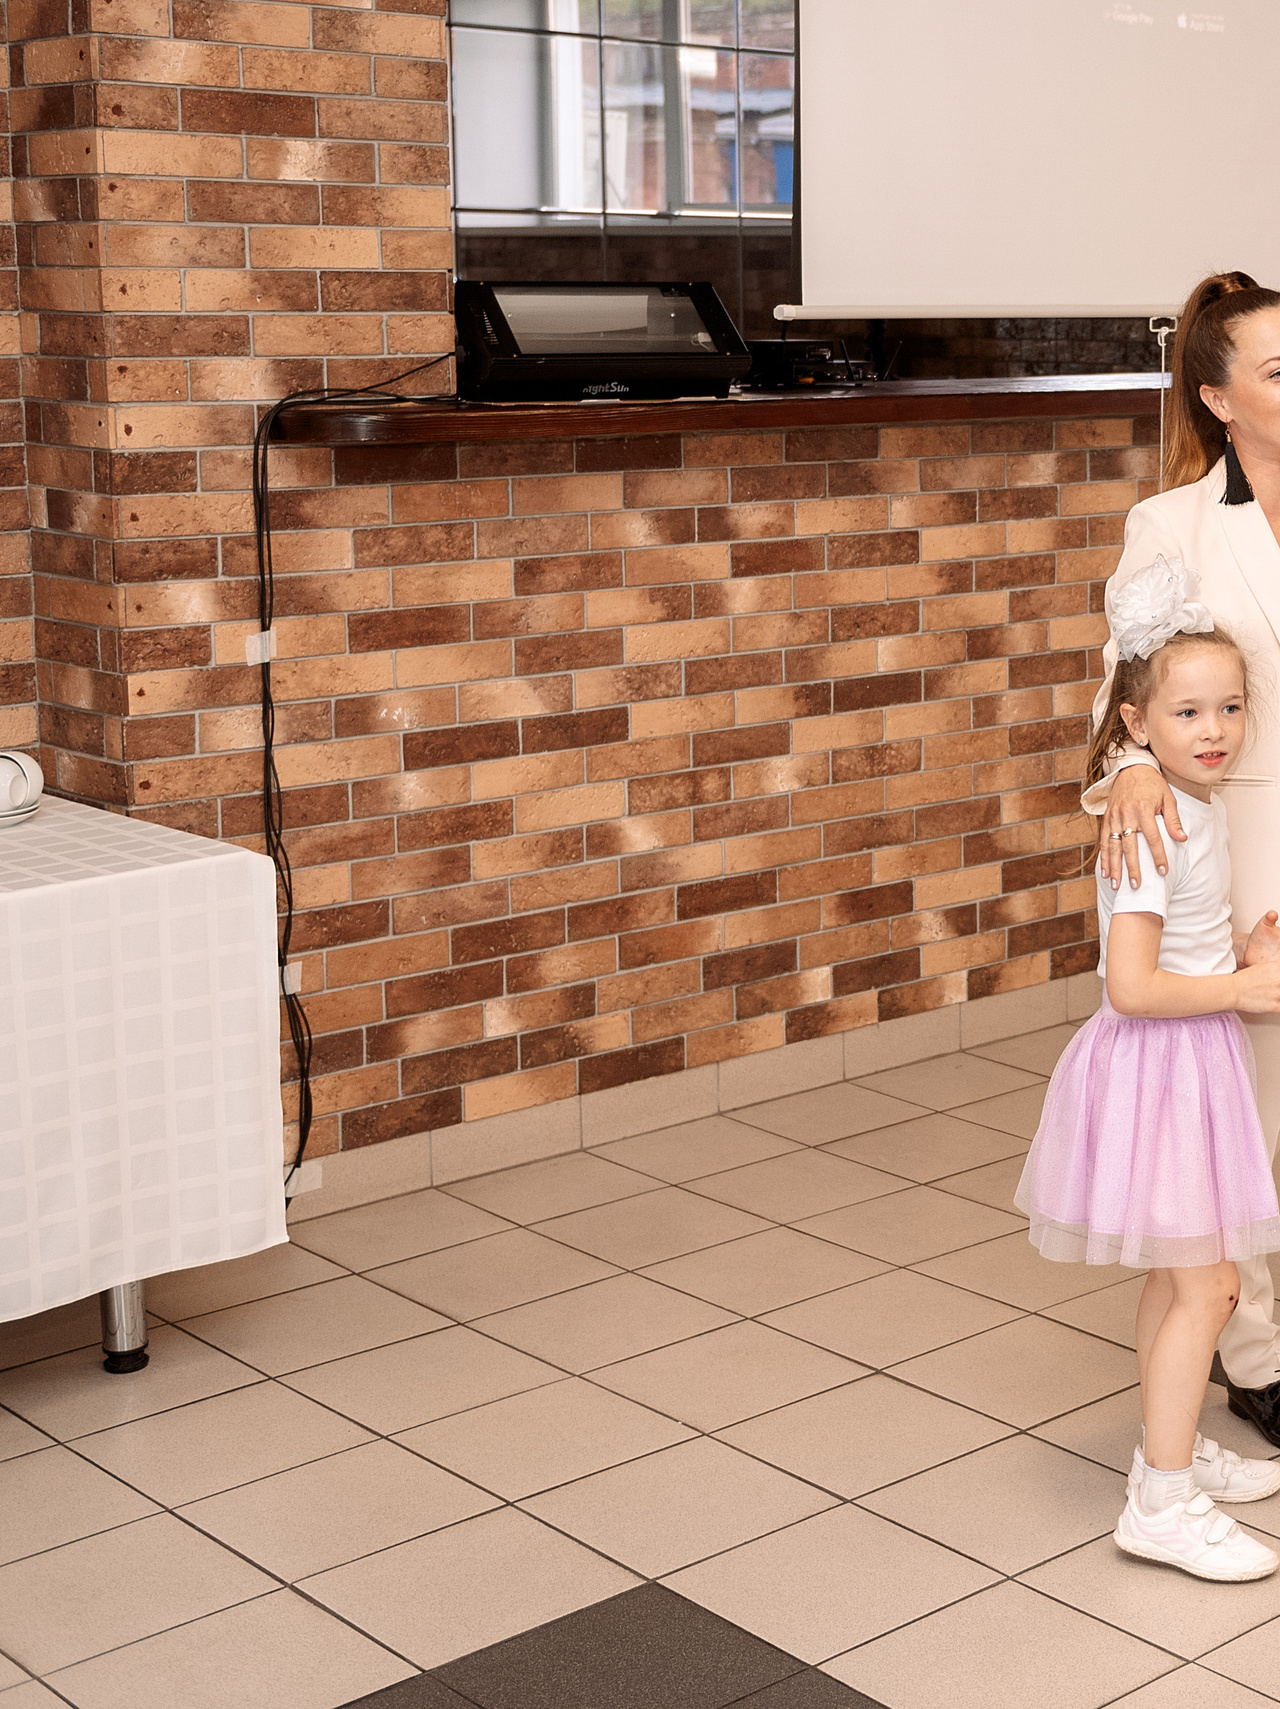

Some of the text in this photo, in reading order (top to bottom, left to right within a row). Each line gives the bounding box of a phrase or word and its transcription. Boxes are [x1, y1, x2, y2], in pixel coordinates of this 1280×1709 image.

[1112, 10, 1154, 26] Google Play
[1189, 20, 1225, 33] App Store
